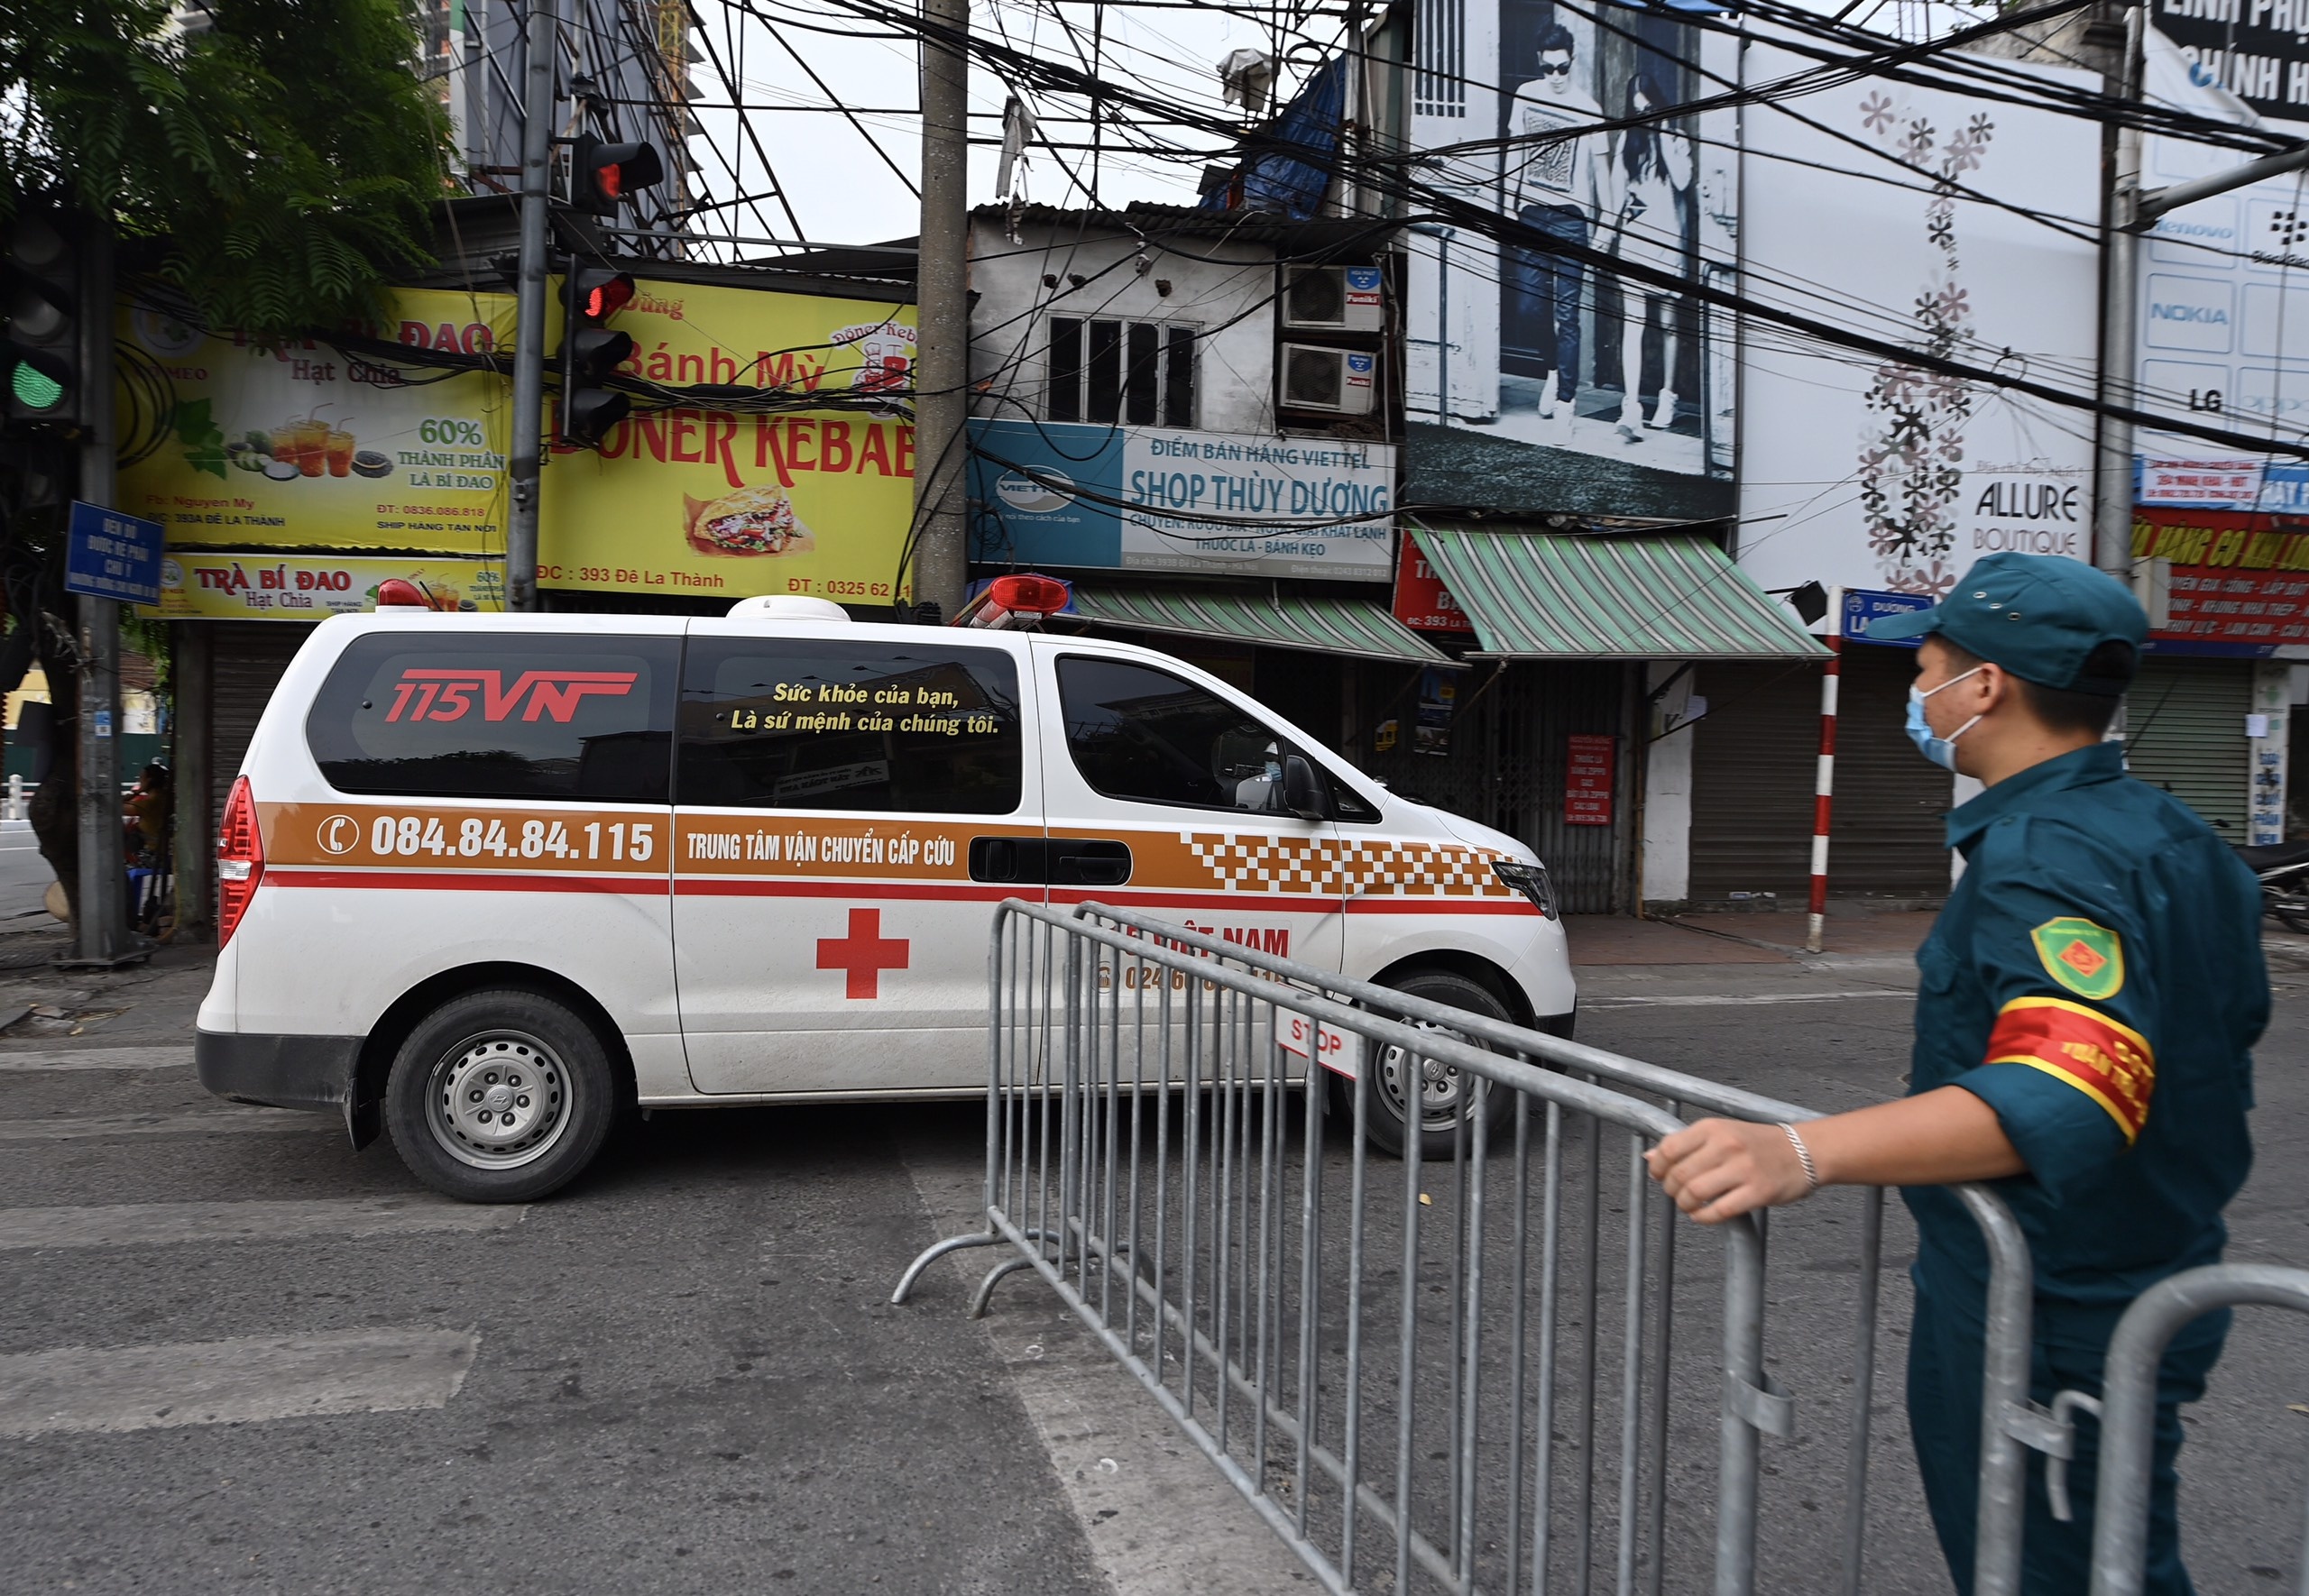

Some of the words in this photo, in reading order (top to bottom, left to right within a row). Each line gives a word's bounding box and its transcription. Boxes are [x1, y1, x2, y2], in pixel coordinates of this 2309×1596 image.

[2151, 302, 2229, 325] NOKIA
[832, 323, 917, 343] Döner-Keb
[291, 359, 336, 386] Hạt
[347, 360, 401, 385] Chia
[2190, 389, 2222, 412] LG
[419, 418, 482, 445] 60%
[397, 451, 454, 467] THÀNH
[755, 415, 916, 489] KEBAB
[1151, 436, 1198, 458] ĐIỂM
[1203, 440, 1241, 462] BÁN
[1246, 445, 1298, 464] HÀNG
[1302, 449, 1371, 470] VIETTEL
[409, 472, 430, 486] LÀ
[436, 472, 452, 488] BÍ
[456, 476, 493, 489] ĐAO
[1131, 470, 1205, 509] SHOP
[1211, 470, 1284, 513] THÙY
[1291, 476, 1388, 518] DƯƠNG
[1975, 482, 2078, 522] ALLURE
[225, 515, 241, 525] LA
[377, 521, 405, 529] SHIP
[1265, 539, 1299, 555] BÁNH
[1301, 543, 1326, 559] KẸO
[1973, 527, 2076, 555] BOUTIQUE
[194, 563, 251, 595] TRÀ
[259, 564, 286, 590] BÍ
[295, 570, 352, 592] ĐAO
[537, 564, 562, 580] ĐC
[579, 567, 610, 582] 393
[615, 569, 639, 583] Đê
[645, 570, 665, 584] La
[670, 572, 724, 588] Thành
[787, 578, 812, 592] ĐT
[827, 580, 866, 595] 0325
[870, 582, 889, 597] 62
[246, 592, 273, 610] Hạt
[279, 592, 313, 608] Chia
[1424, 615, 1447, 626] 393
[772, 682, 812, 703] Sức
[817, 682, 869, 706] khỏe
[874, 683, 910, 706] của
[916, 686, 960, 710] bạn,
[731, 709, 757, 729] Là
[763, 710, 793, 729] sứ
[795, 711, 851, 735] mệnh
[857, 710, 894, 732] của
[899, 711, 960, 736] chúng
[967, 715, 999, 734] tôi.
[370, 814, 654, 862] 084.84.84.115
[686, 831, 741, 861] TRUNG
[744, 828, 780, 861] TÂM
[784, 831, 817, 867] VẬN
[821, 827, 884, 865] CHUYỂN
[888, 830, 919, 866] CẤP
[924, 833, 956, 867] CỨU
[1223, 927, 1290, 959] NAM
[1291, 1018, 1343, 1056] STOP
